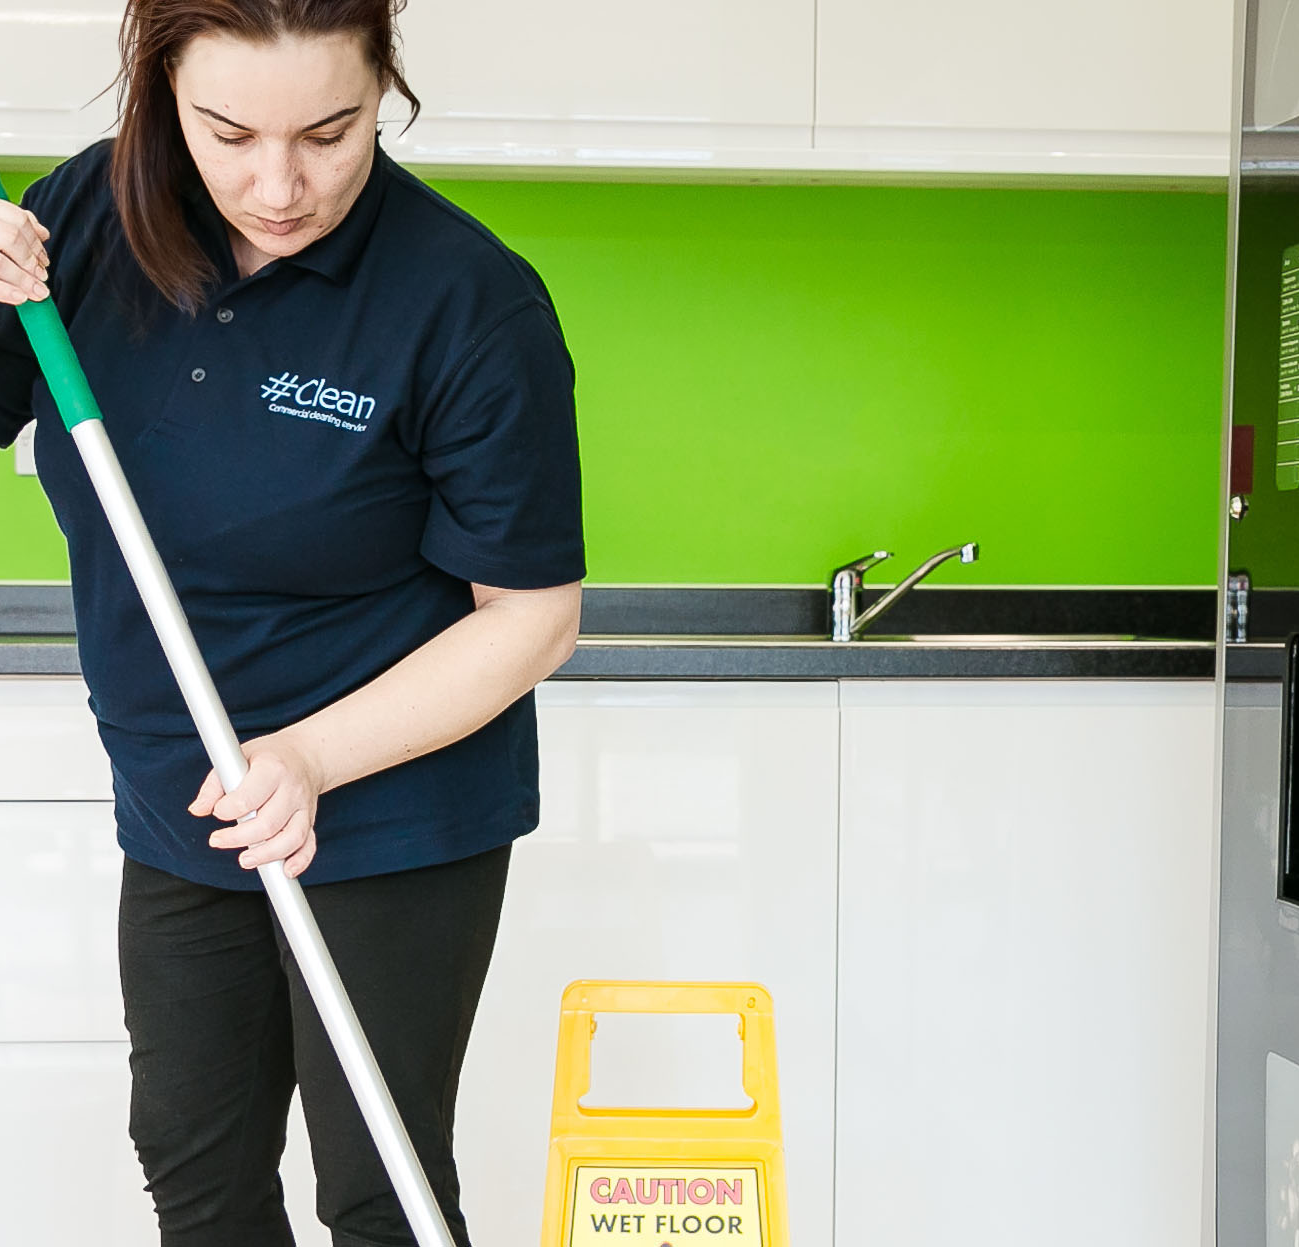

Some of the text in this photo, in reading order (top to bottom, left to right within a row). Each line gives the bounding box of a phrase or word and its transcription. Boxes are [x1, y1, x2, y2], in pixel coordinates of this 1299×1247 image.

[261, 372, 376, 419] #Clean
[590, 1177, 743, 1205] CAUTION
[590, 1214, 743, 1234] WET FLOOR
